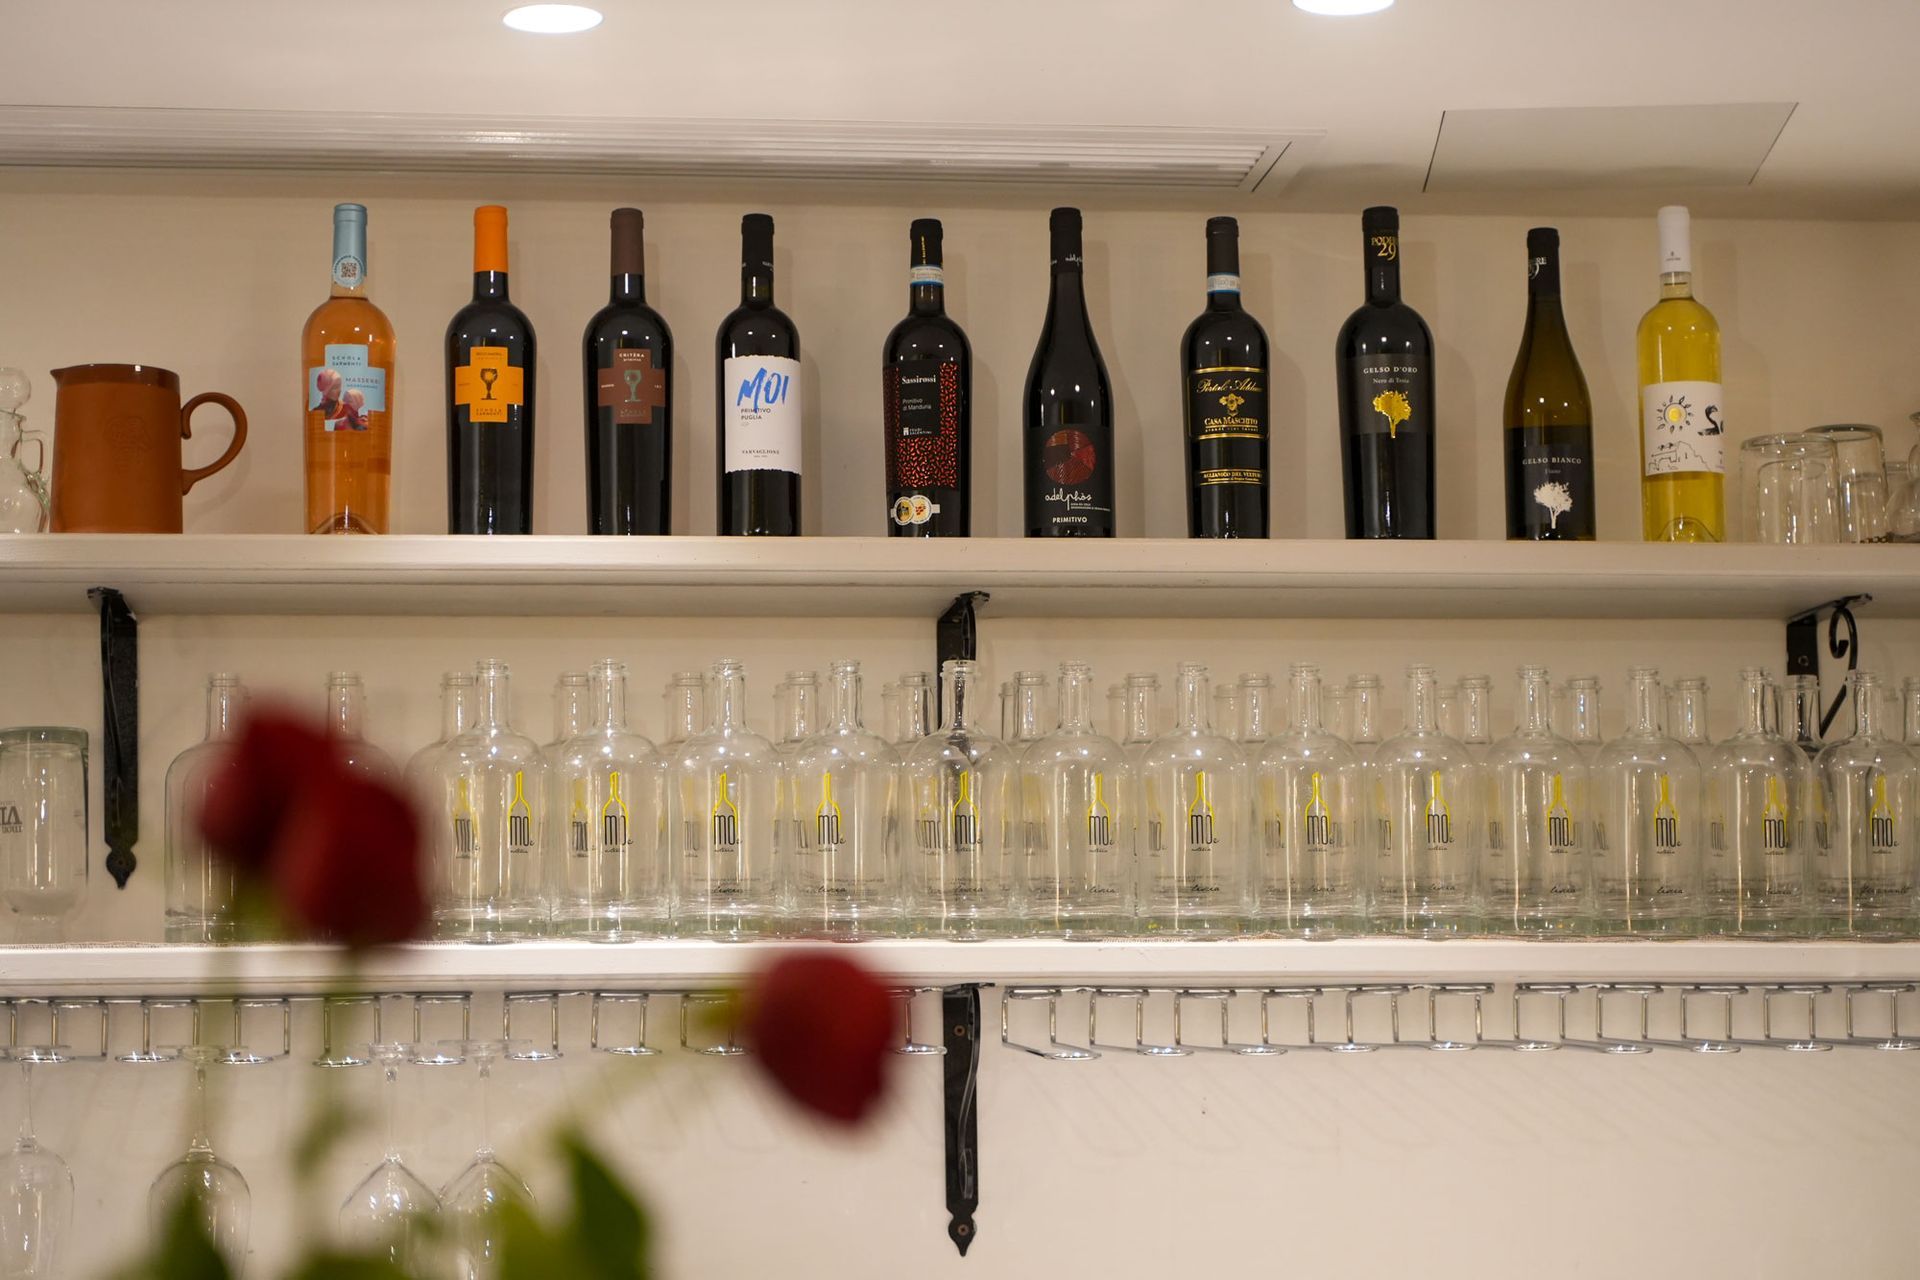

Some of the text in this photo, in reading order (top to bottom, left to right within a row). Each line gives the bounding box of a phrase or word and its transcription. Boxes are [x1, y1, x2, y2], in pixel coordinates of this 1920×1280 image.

[1377, 243, 1396, 261] 29
[1363, 366, 1418, 374] GELSO D'ORO
[901, 374, 937, 385] Sassirossi
[736, 367, 790, 413] MOI
[1204, 417, 1223, 426] CASA
[1522, 457, 1582, 465] GELSO BIANCO
